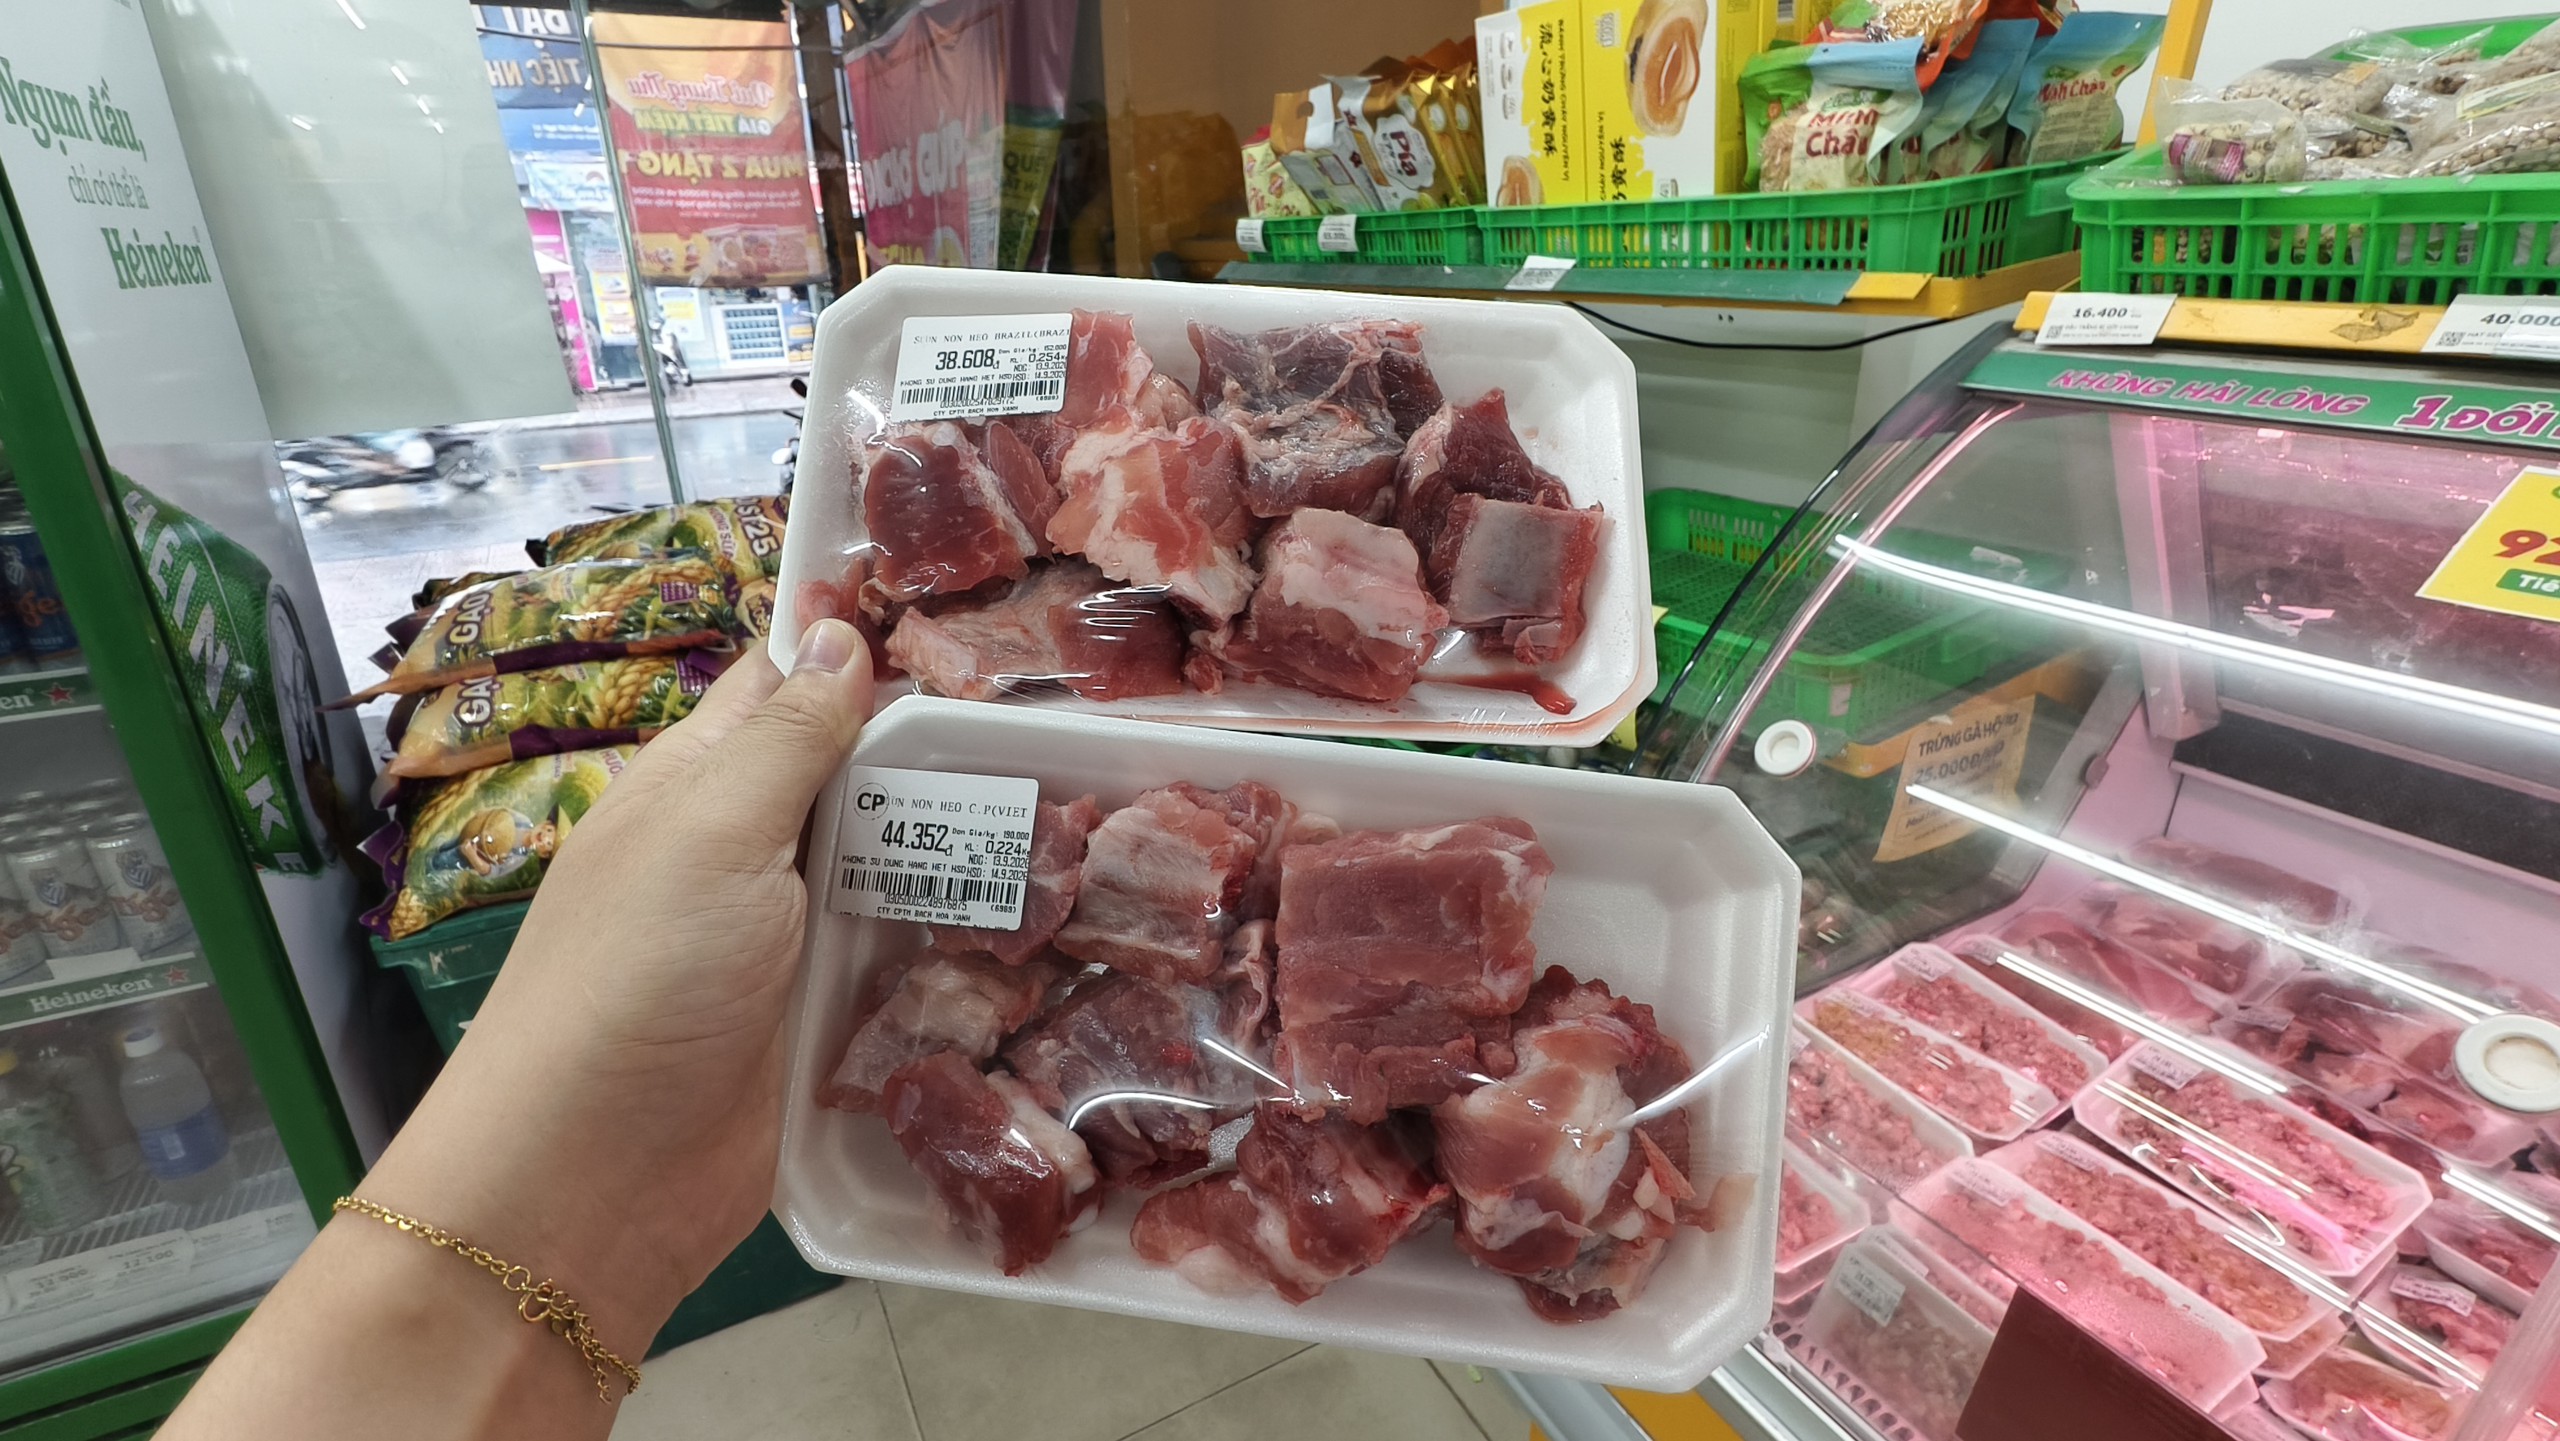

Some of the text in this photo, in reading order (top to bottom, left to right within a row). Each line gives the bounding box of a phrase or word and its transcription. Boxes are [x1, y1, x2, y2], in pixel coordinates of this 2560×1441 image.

[0, 56, 93, 156] Ngụm
[100, 226, 212, 289] Heineken
[2073, 307, 2128, 319] 16.400
[944, 334, 963, 343] NON
[939, 377, 956, 385] DUNG
[2049, 369, 2175, 398] KHÔNG
[2394, 395, 2453, 429] 1
[2441, 401, 2558, 438] ĐỔI
[454, 676, 503, 728] GẠ
[857, 792, 886, 812] CP
[911, 798, 933, 810] NON
[940, 801, 962, 813] HEO
[1003, 830, 1030, 841] 190.000
[842, 856, 966, 874] KHONG SU DUNG HANG HET HSD
[966, 866, 986, 879] HSD:
[877, 906, 890, 915] CTY
[894, 908, 911, 917] CPTM
[915, 909, 932, 919] BACH
[935, 911, 949, 920] HOA
[952, 913, 971, 923] XANH
[30, 977, 154, 1013] Heineken
